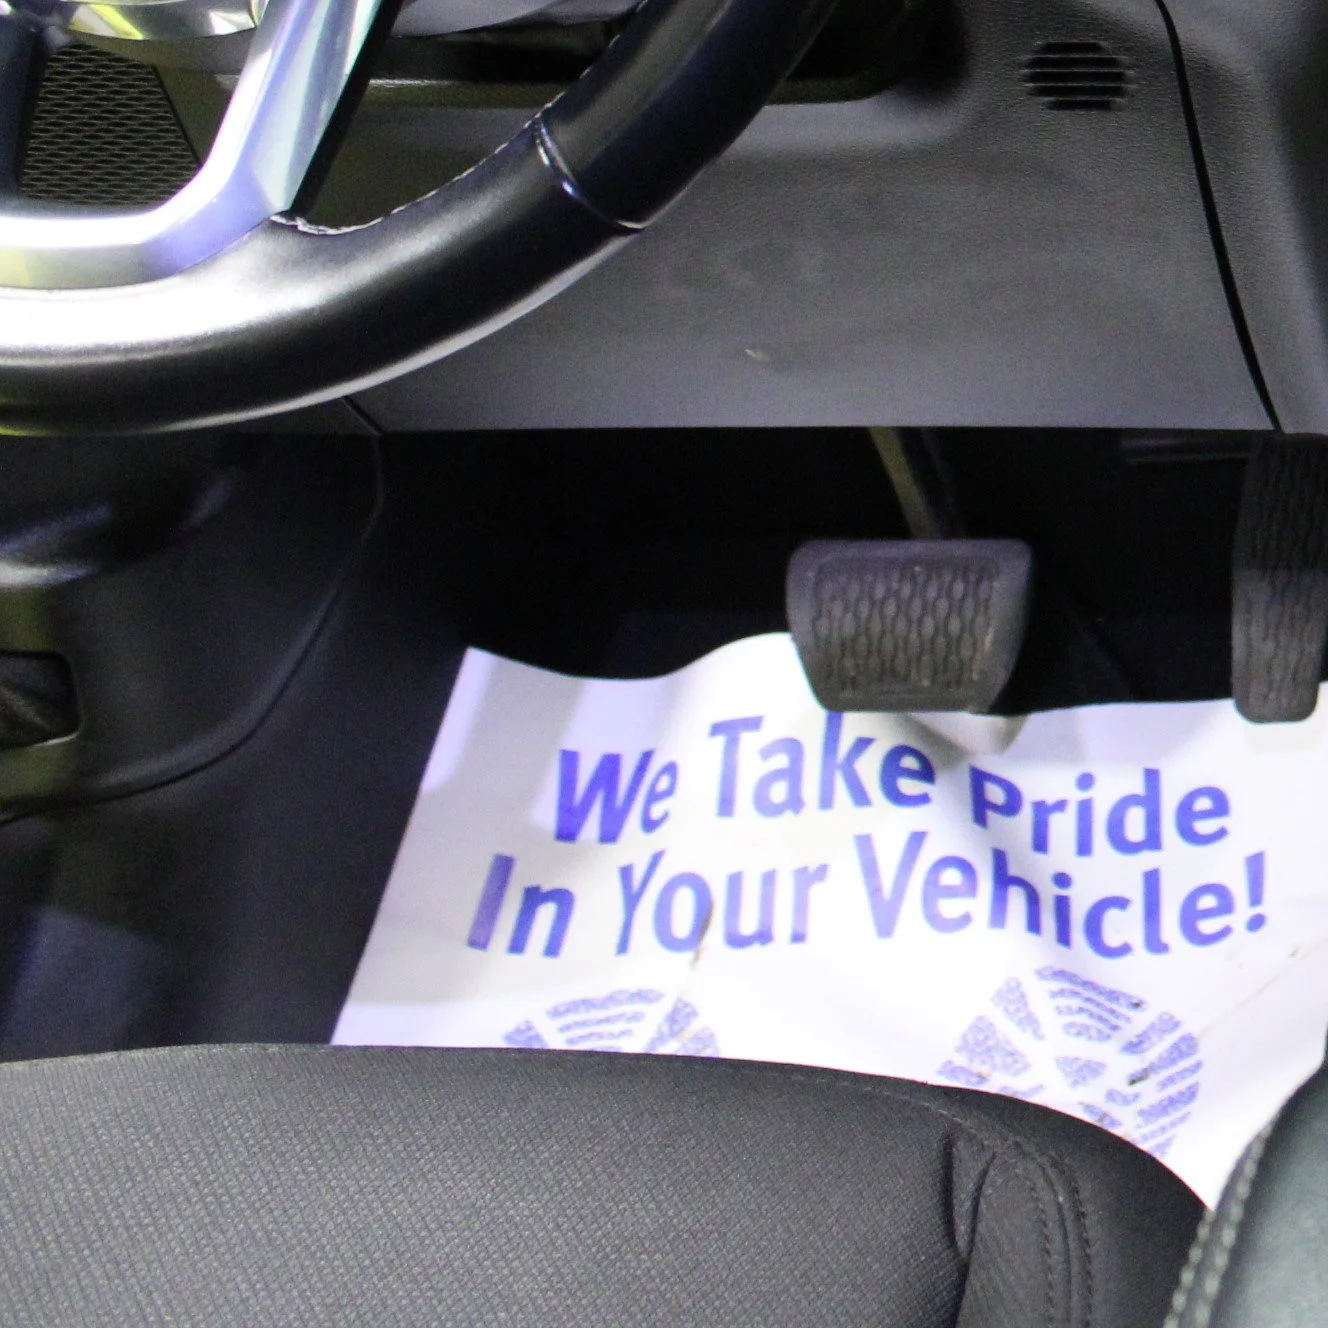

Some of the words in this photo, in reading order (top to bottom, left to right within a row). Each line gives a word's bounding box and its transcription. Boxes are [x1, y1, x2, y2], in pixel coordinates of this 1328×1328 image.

[552, 746, 678, 845] We
[708, 711, 935, 819] Take
[968, 764, 1231, 858] Pride
[466, 854, 574, 959] In
[613, 849, 827, 956] Your
[854, 830, 1268, 960] Vehicle!
